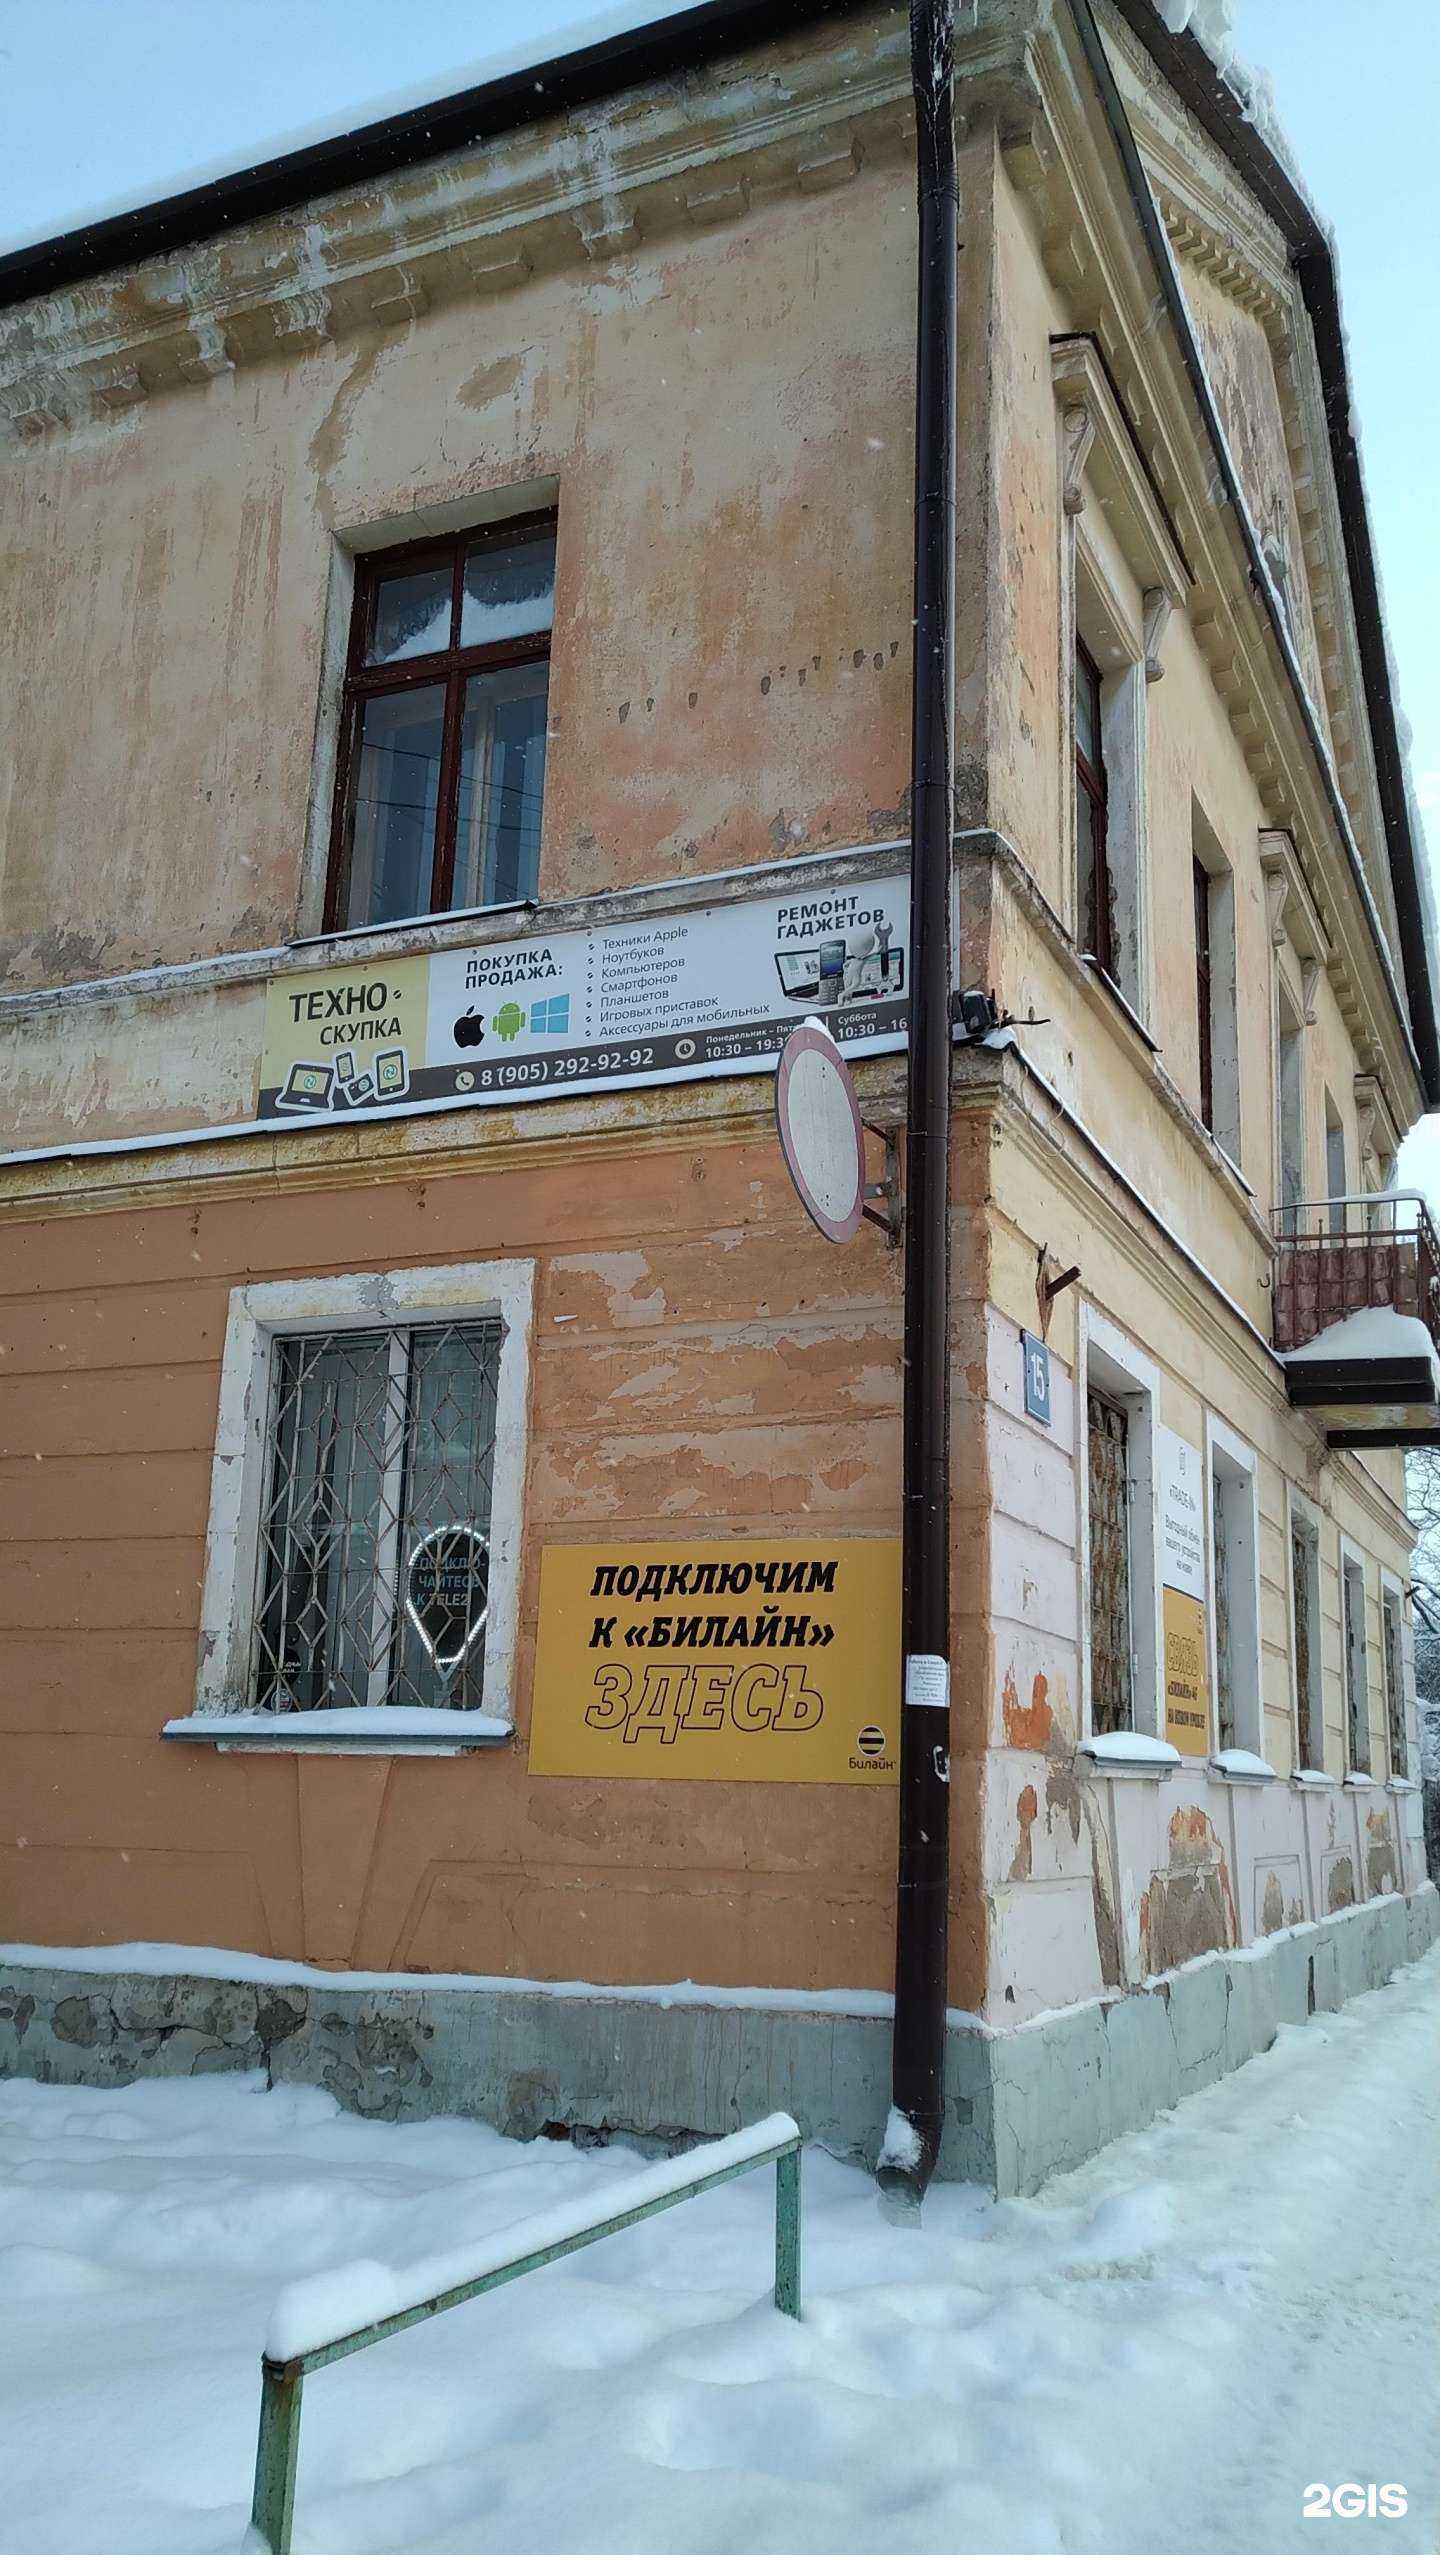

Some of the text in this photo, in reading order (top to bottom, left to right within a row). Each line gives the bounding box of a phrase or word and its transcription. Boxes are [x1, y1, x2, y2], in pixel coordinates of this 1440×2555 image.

[777, 896, 859, 923] РЕМОНТ
[776, 908, 885, 939] ГАДЖЕТОВ
[603, 927, 689, 950] Техники Apple
[467, 949, 552, 974] ПОКУПКА
[602, 946, 665, 965] Ноутбуков
[465, 964, 563, 989] ПРОДАЖА:
[601, 958, 686, 979] Компьютеров
[600, 974, 678, 994] Смартфонов
[289, 982, 388, 1023] ТЕХНО
[600, 989, 669, 1009] Планшетов
[600, 997, 719, 1023] Игровых приставок
[600, 1004, 771, 1037] Аксессуары для мобильных
[838, 1012, 877, 1025] Суббота
[838, 1023, 875, 1039] 10:30
[320, 1017, 402, 1046] СКУПКА
[706, 1029, 767, 1044] Понедельник
[706, 1043, 742, 1059] 10:30
[756, 1037, 788, 1051] 19:3
[481, 1047, 654, 1086] 8 (905) 292-92-92
[1031, 1352, 1045, 1402] 15
[590, 1561, 839, 1602] ПОДКЛЮЧИМ
[589, 1605, 836, 1649] К «БИЛАЙН»
[585, 1663, 824, 1744] ЗДЕСЬ
[849, 1757, 894, 1770] Билайн
